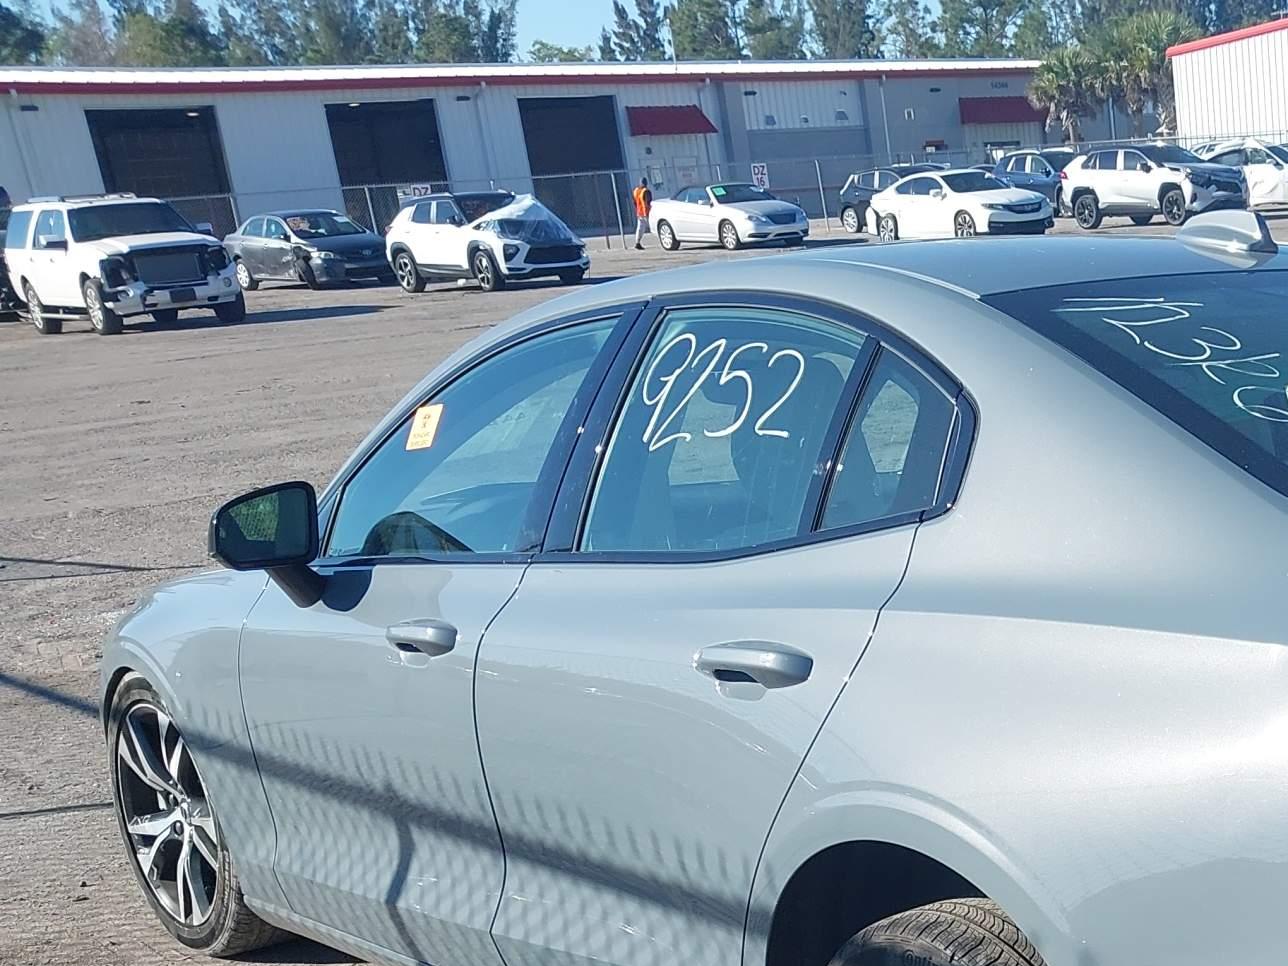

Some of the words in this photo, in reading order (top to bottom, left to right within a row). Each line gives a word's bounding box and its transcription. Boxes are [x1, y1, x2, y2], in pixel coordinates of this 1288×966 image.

[752, 165, 766, 176] DZ
[756, 176, 766, 187] 16
[642, 332, 805, 452] 9252
